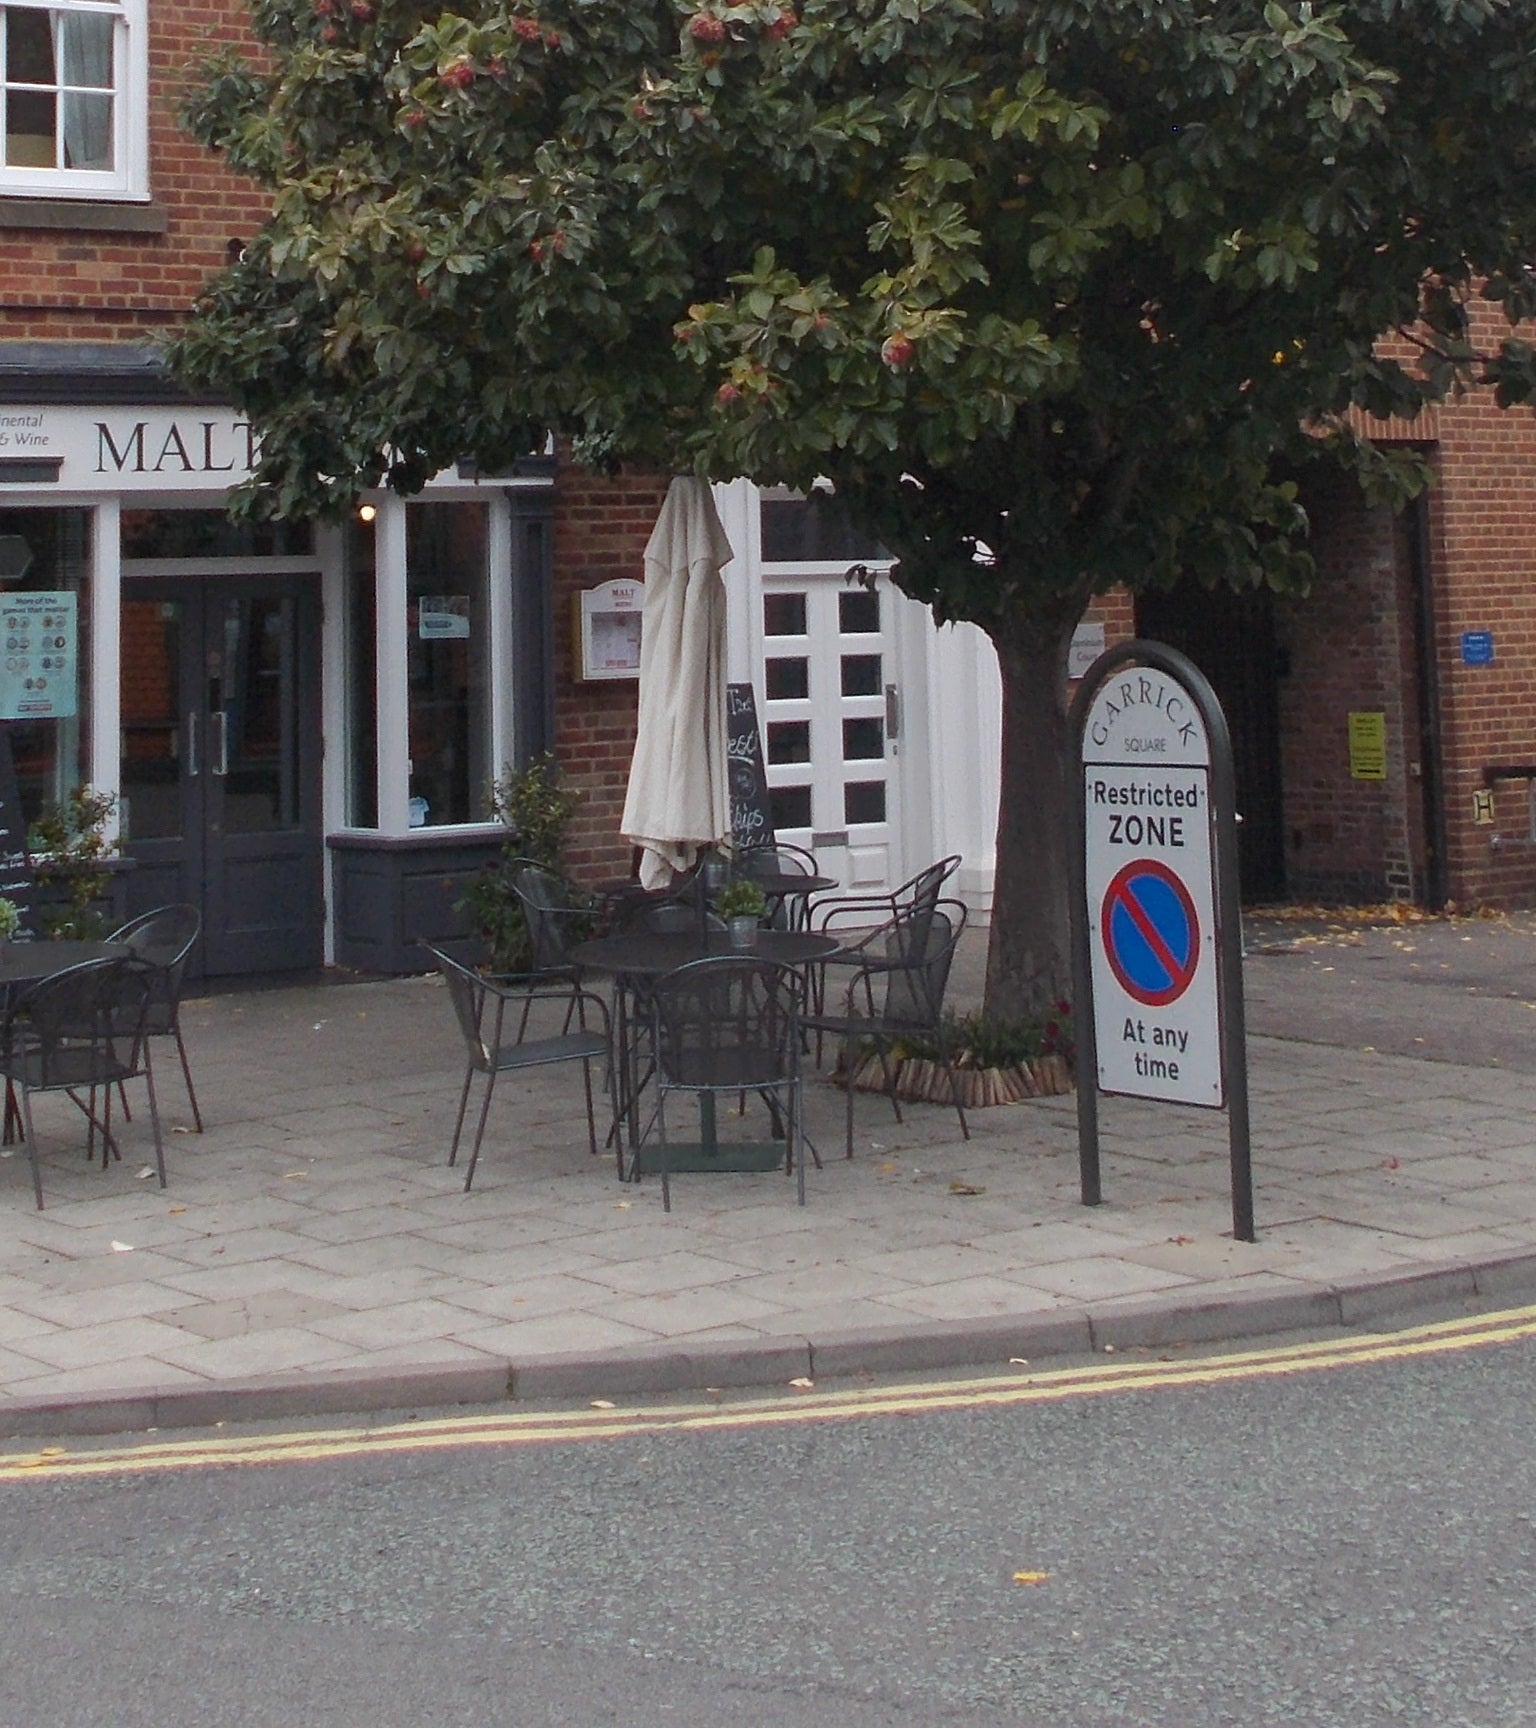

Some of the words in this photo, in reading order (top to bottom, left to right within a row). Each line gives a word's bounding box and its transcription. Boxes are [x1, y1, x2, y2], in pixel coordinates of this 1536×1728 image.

[0, 432, 10, 446] &
[15, 432, 49, 446] Wine
[92, 421, 254, 473] MALT
[1092, 679, 1197, 748] GARRICK
[1124, 738, 1167, 753] SQUARE
[1094, 781, 1198, 808] Restricted
[1109, 815, 1185, 848] ZONE
[1123, 1018, 1145, 1044] At
[1153, 1027, 1188, 1053] any
[1135, 1052, 1179, 1080] time
